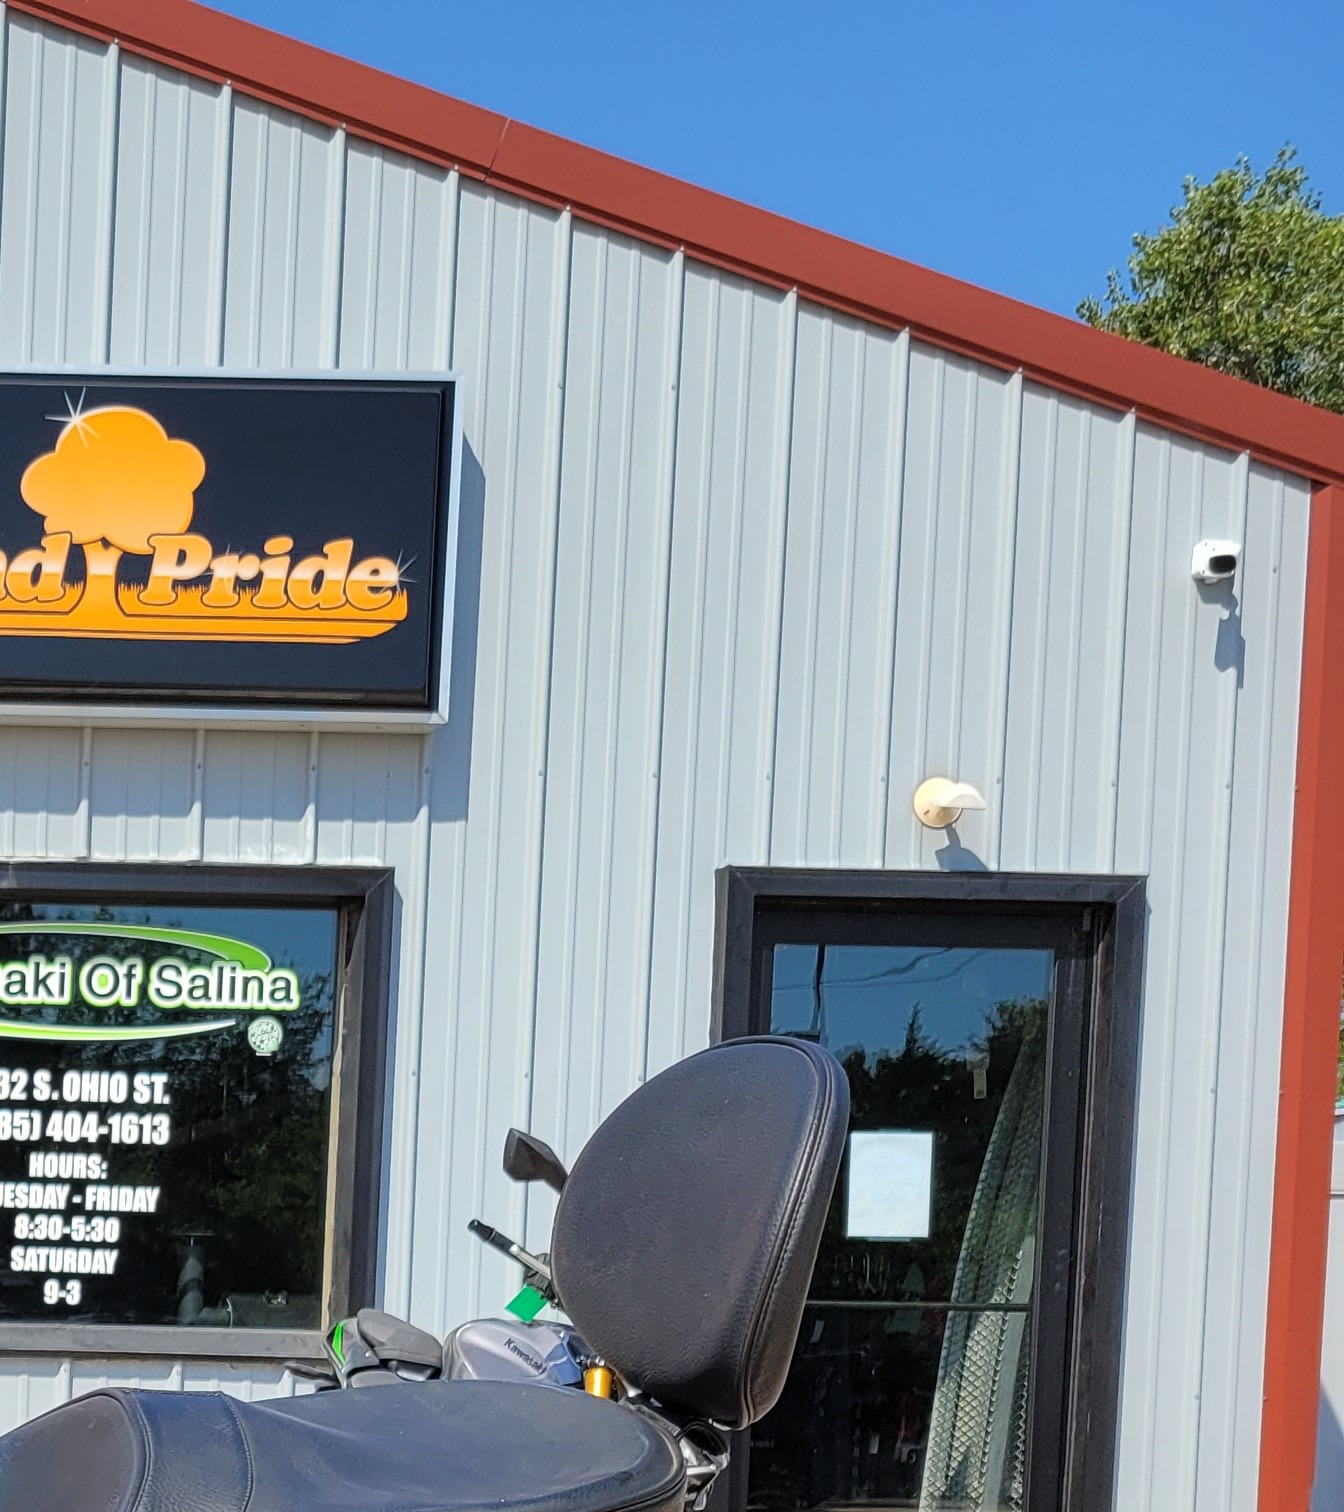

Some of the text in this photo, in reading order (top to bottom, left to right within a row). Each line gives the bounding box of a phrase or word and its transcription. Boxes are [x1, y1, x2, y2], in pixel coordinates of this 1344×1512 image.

[139, 532, 400, 611] Pride
[85, 961, 139, 1001] Of
[154, 964, 294, 1004] Salina
[33, 1069, 59, 1101] S.
[62, 1070, 128, 1103] OHIO
[133, 1072, 170, 1104] ST.
[46, 1110, 170, 1145] 404-1613
[29, 1151, 108, 1179] HOURS:
[85, 1184, 160, 1213] FRIDAY
[14, 1213, 120, 1243] 8:30-5:30
[10, 1245, 119, 1275] SATURDAY
[43, 1278, 82, 1306] 9-3
[503, 1337, 548, 1375] Kawasaki
